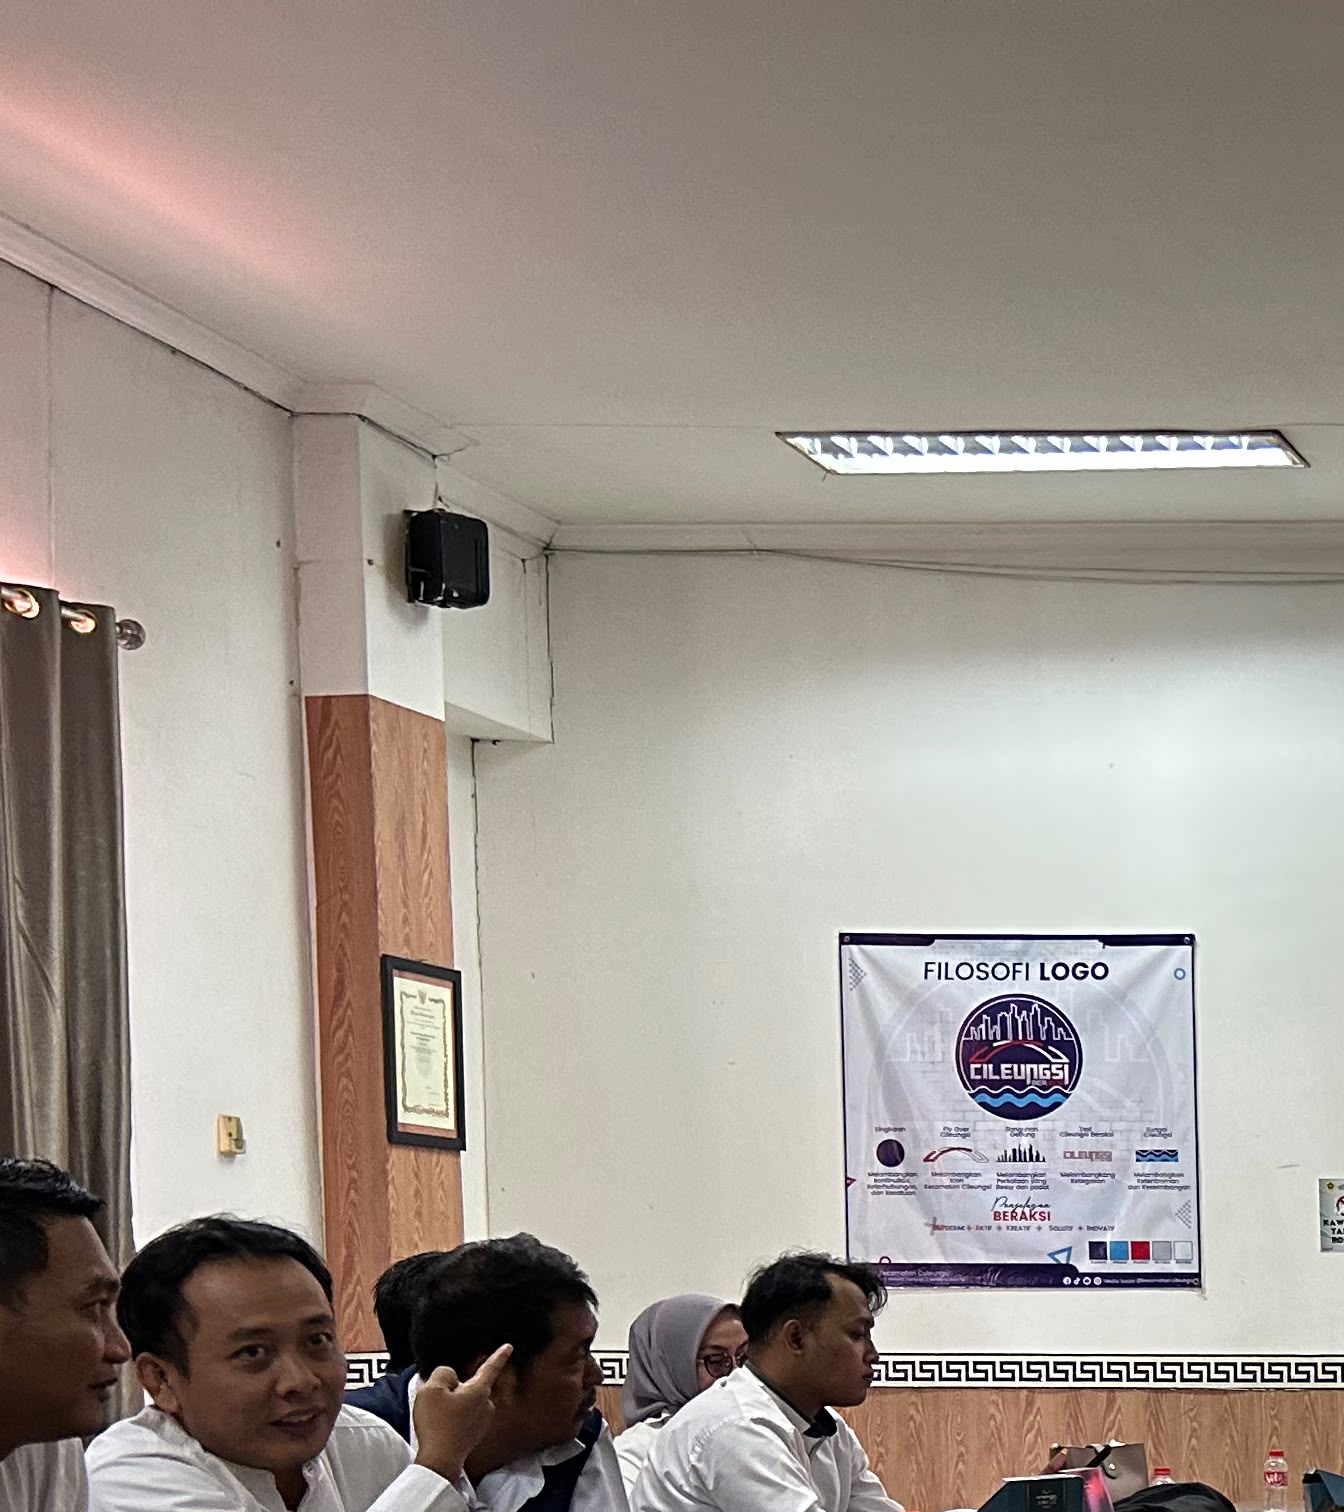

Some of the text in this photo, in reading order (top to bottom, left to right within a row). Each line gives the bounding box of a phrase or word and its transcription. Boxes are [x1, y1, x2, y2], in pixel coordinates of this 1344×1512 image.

[923, 961, 1109, 982] FILOSOFI LOGO
[970, 1063, 1069, 1085] CILEUNGSI
[993, 1211, 1051, 1222] BERAKSI
